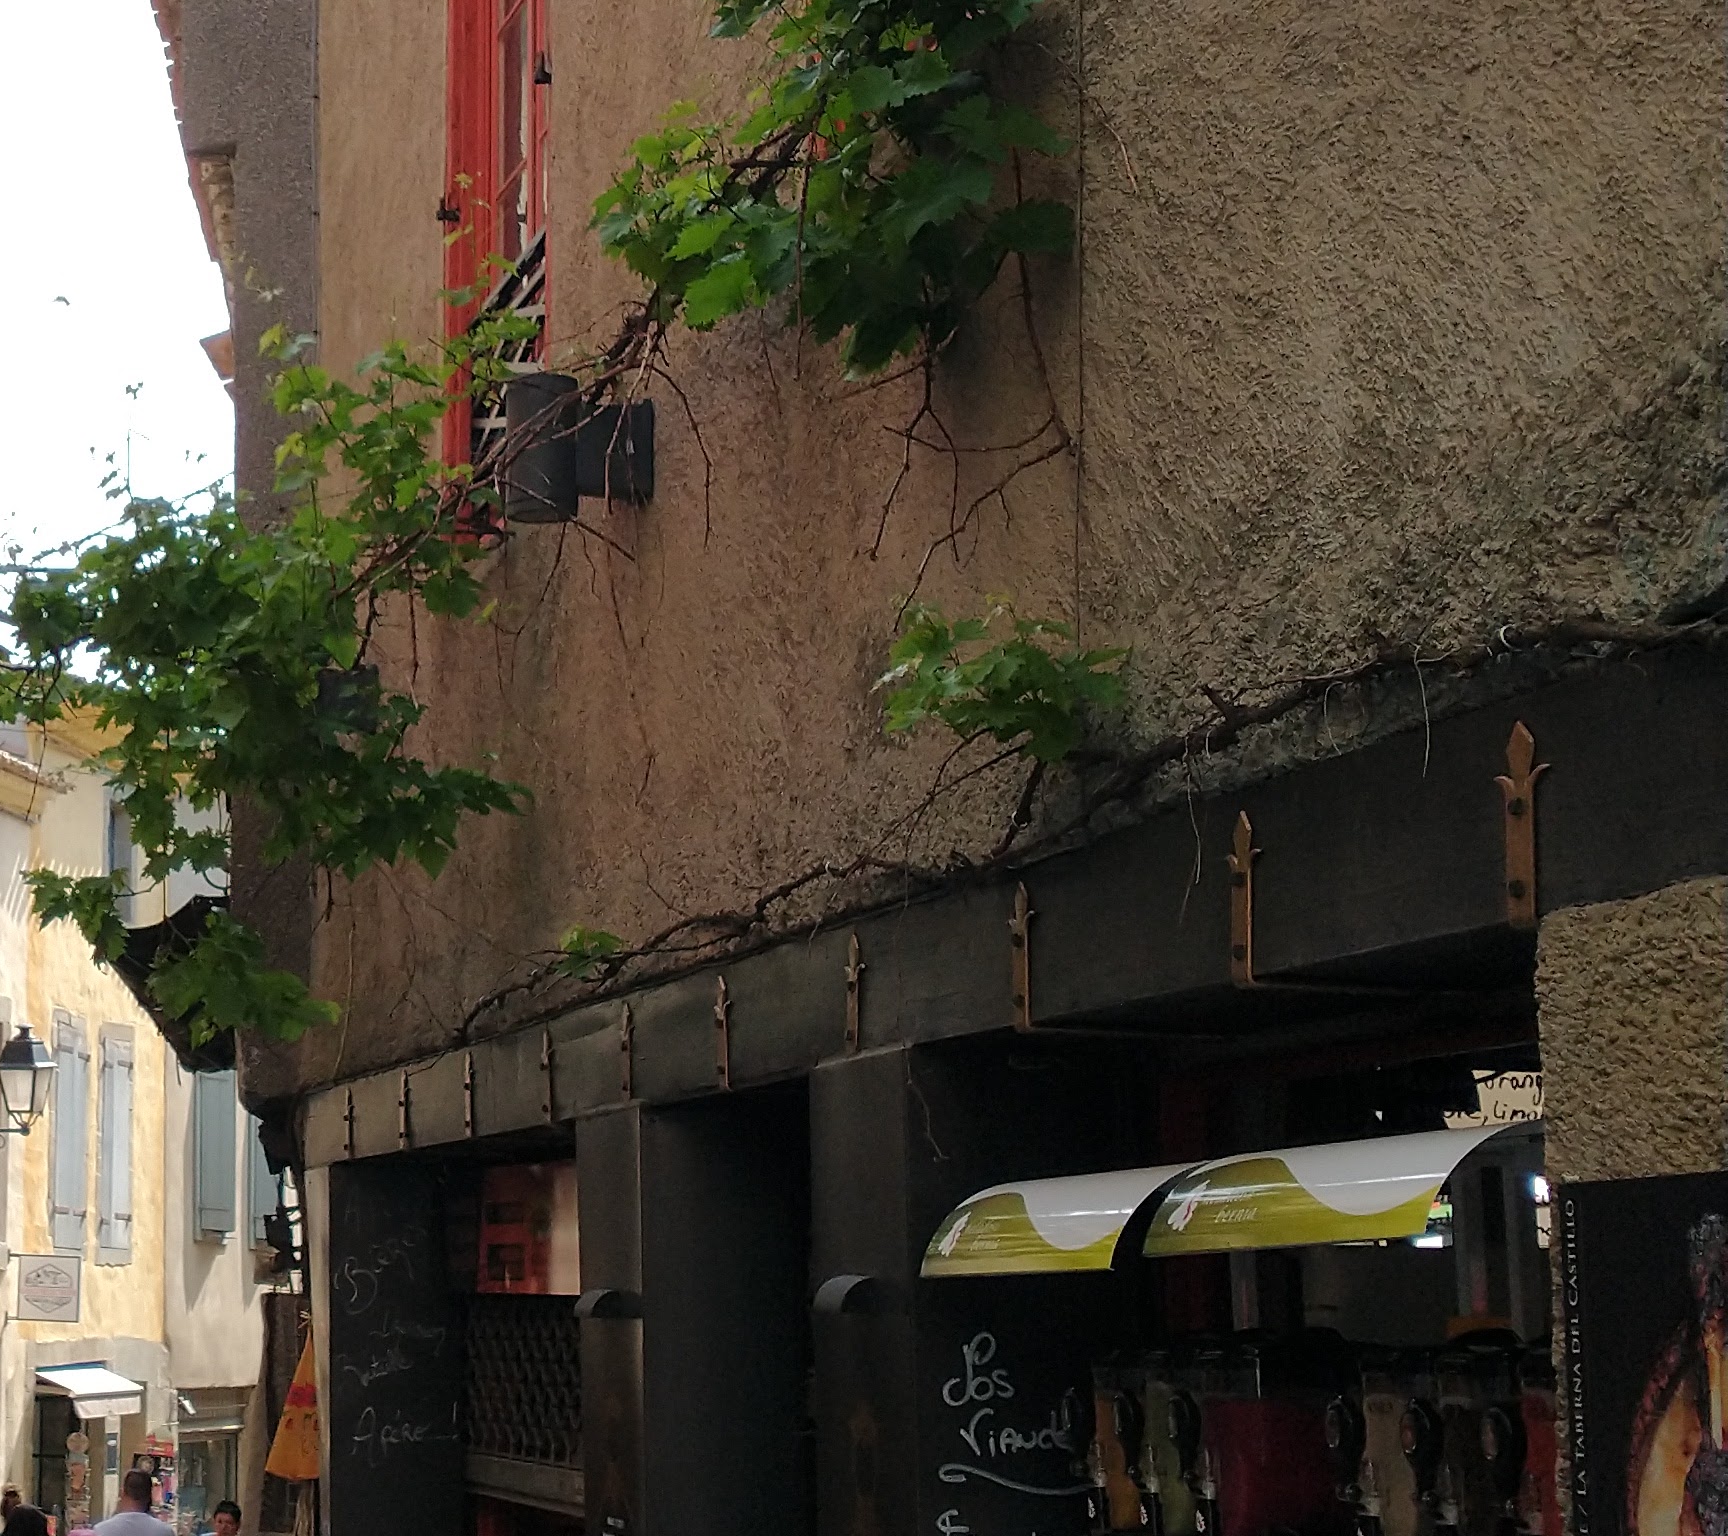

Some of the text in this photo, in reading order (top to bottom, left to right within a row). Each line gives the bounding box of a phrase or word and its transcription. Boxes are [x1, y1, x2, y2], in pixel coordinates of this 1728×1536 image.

[1565, 1199, 1579, 1306] CASTILLO
[1570, 1316, 1581, 1354] DEL
[1572, 1362, 1585, 1461] TABERNA
